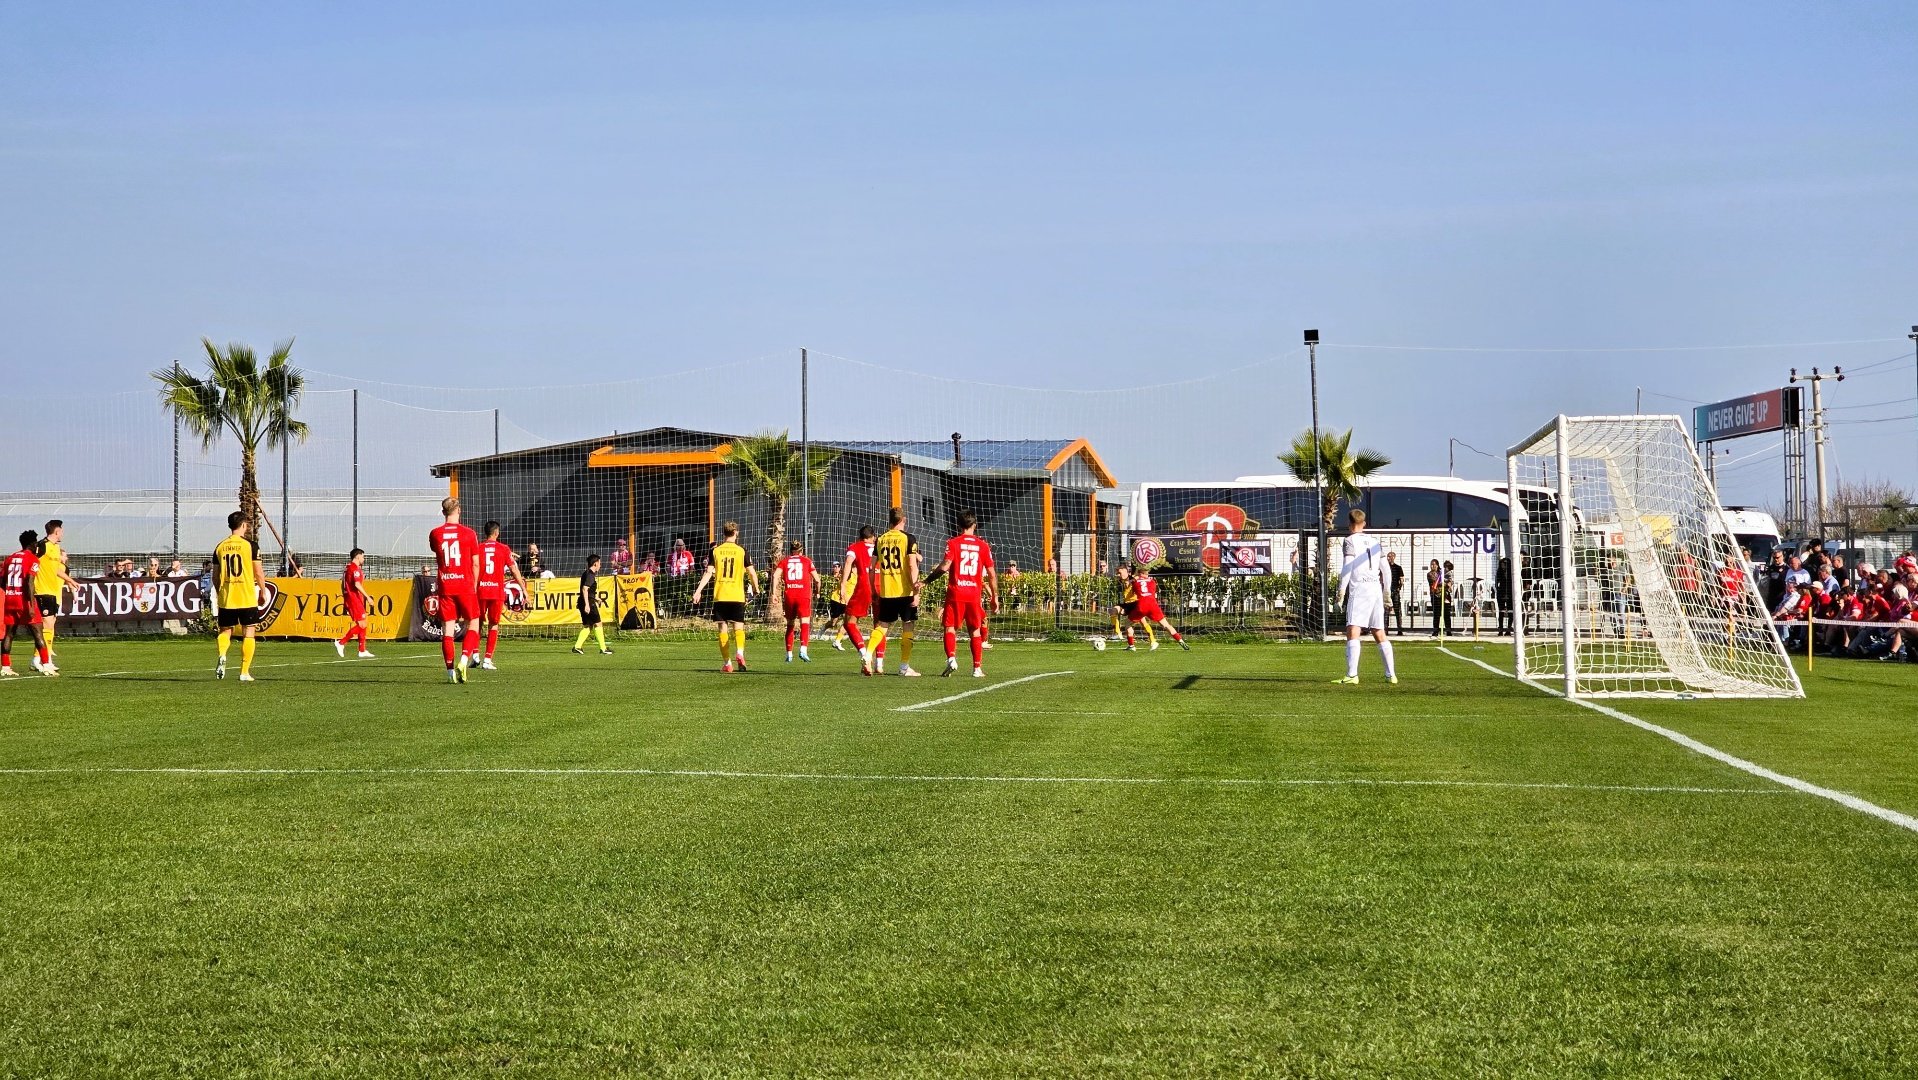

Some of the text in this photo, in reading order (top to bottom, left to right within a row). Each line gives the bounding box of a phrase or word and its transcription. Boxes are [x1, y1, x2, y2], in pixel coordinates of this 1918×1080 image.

[1708, 400, 1769, 432] NEVER GIVE UP
[1272, 536, 1298, 548] HIG
[222, 553, 243, 578] 10
[441, 541, 461, 567] 14
[485, 553, 495, 575] 5
[880, 546, 901, 570] 33
[959, 551, 979, 576] 23
[1366, 548, 1373, 569] 1
[8, 563, 23, 588] 22
[721, 557, 735, 578] 11
[787, 562, 803, 580] 28
[313, 621, 344, 633] Forever
[370, 623, 391, 634] Love
